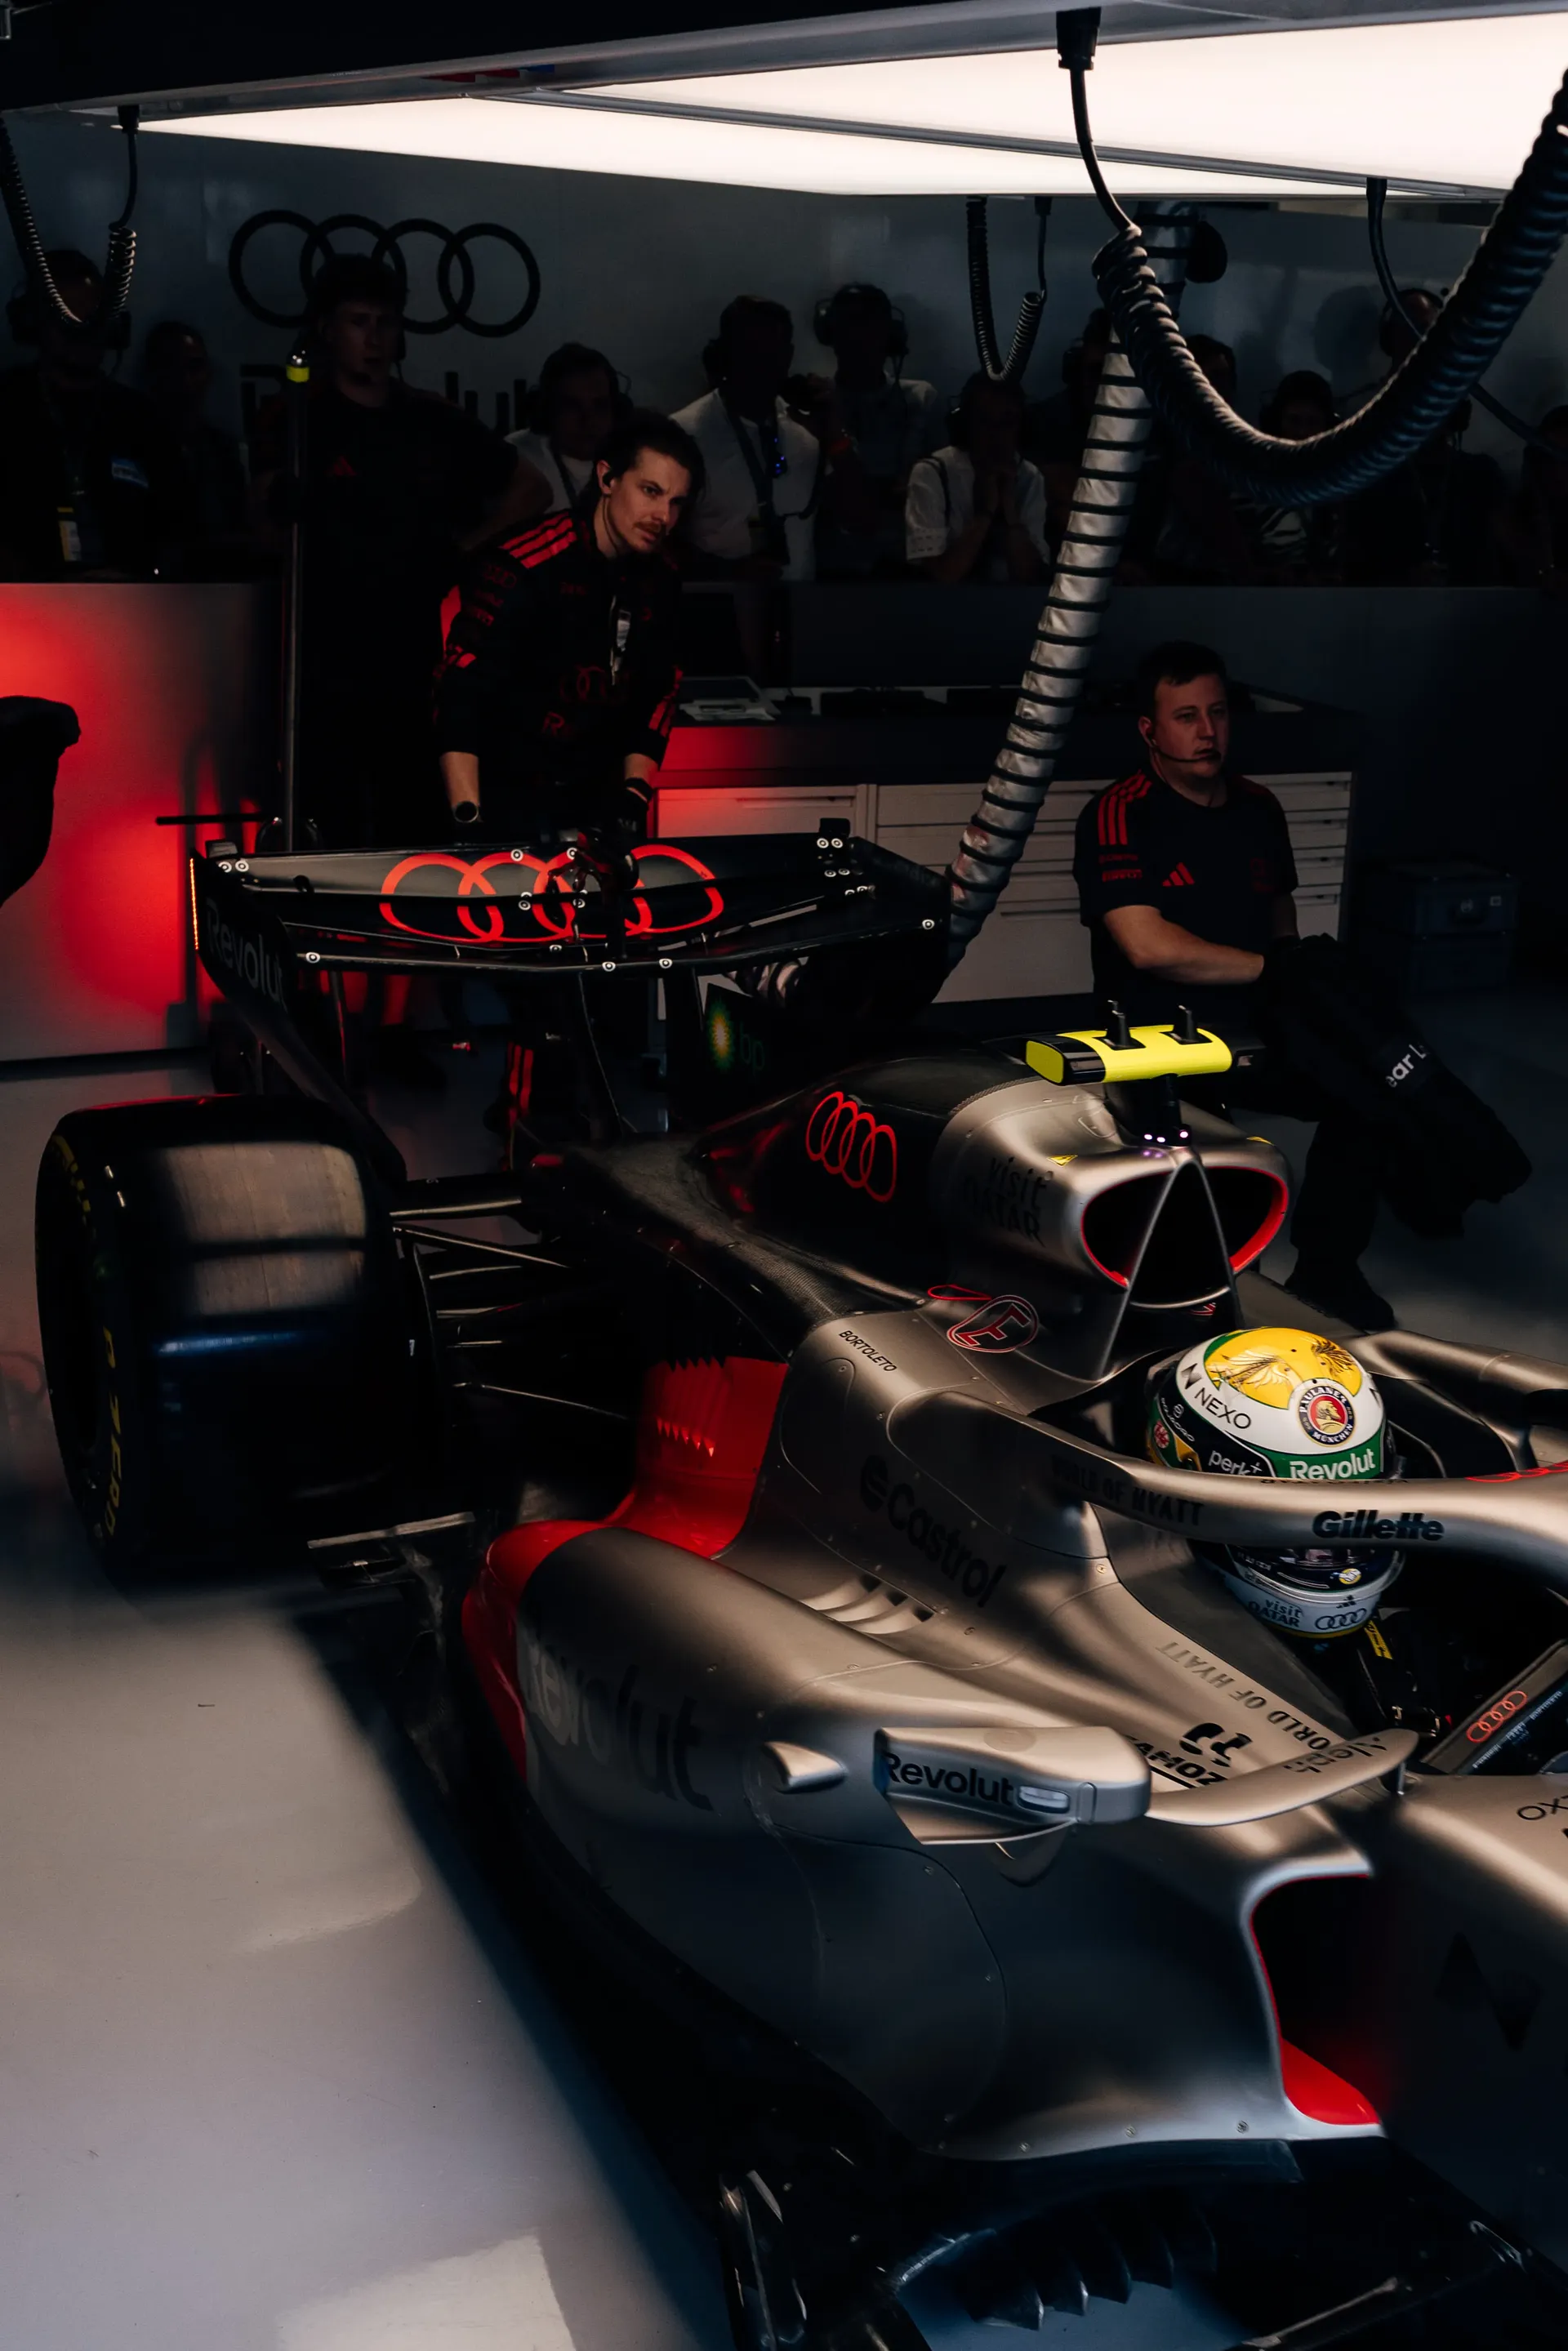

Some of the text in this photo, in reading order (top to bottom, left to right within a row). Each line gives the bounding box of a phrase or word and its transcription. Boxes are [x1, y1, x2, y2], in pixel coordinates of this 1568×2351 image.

[205, 896, 288, 1013] Revolut
[739, 1018, 766, 1079] bp
[1384, 1053, 1415, 1089] ear
[990, 1155, 1047, 1211] visit
[963, 1174, 1046, 1248] QATAR
[839, 1329, 898, 1373] BORTOLETO
[1194, 1387, 1251, 1430] NEXO
[1290, 1448, 1376, 1480] Revolut
[1132, 1487, 1205, 1526] HYATT
[1313, 1510, 1444, 1541] Gillette
[888, 1483, 1008, 1607] Castrol
[1248, 1601, 1300, 1628] QATAR
[1265, 1598, 1303, 1619] visit
[1156, 1641, 1331, 1751] ORLD OF HYATT
[884, 1752, 1013, 1806] Revolut
[1125, 1734, 1228, 1786] AMOZ
